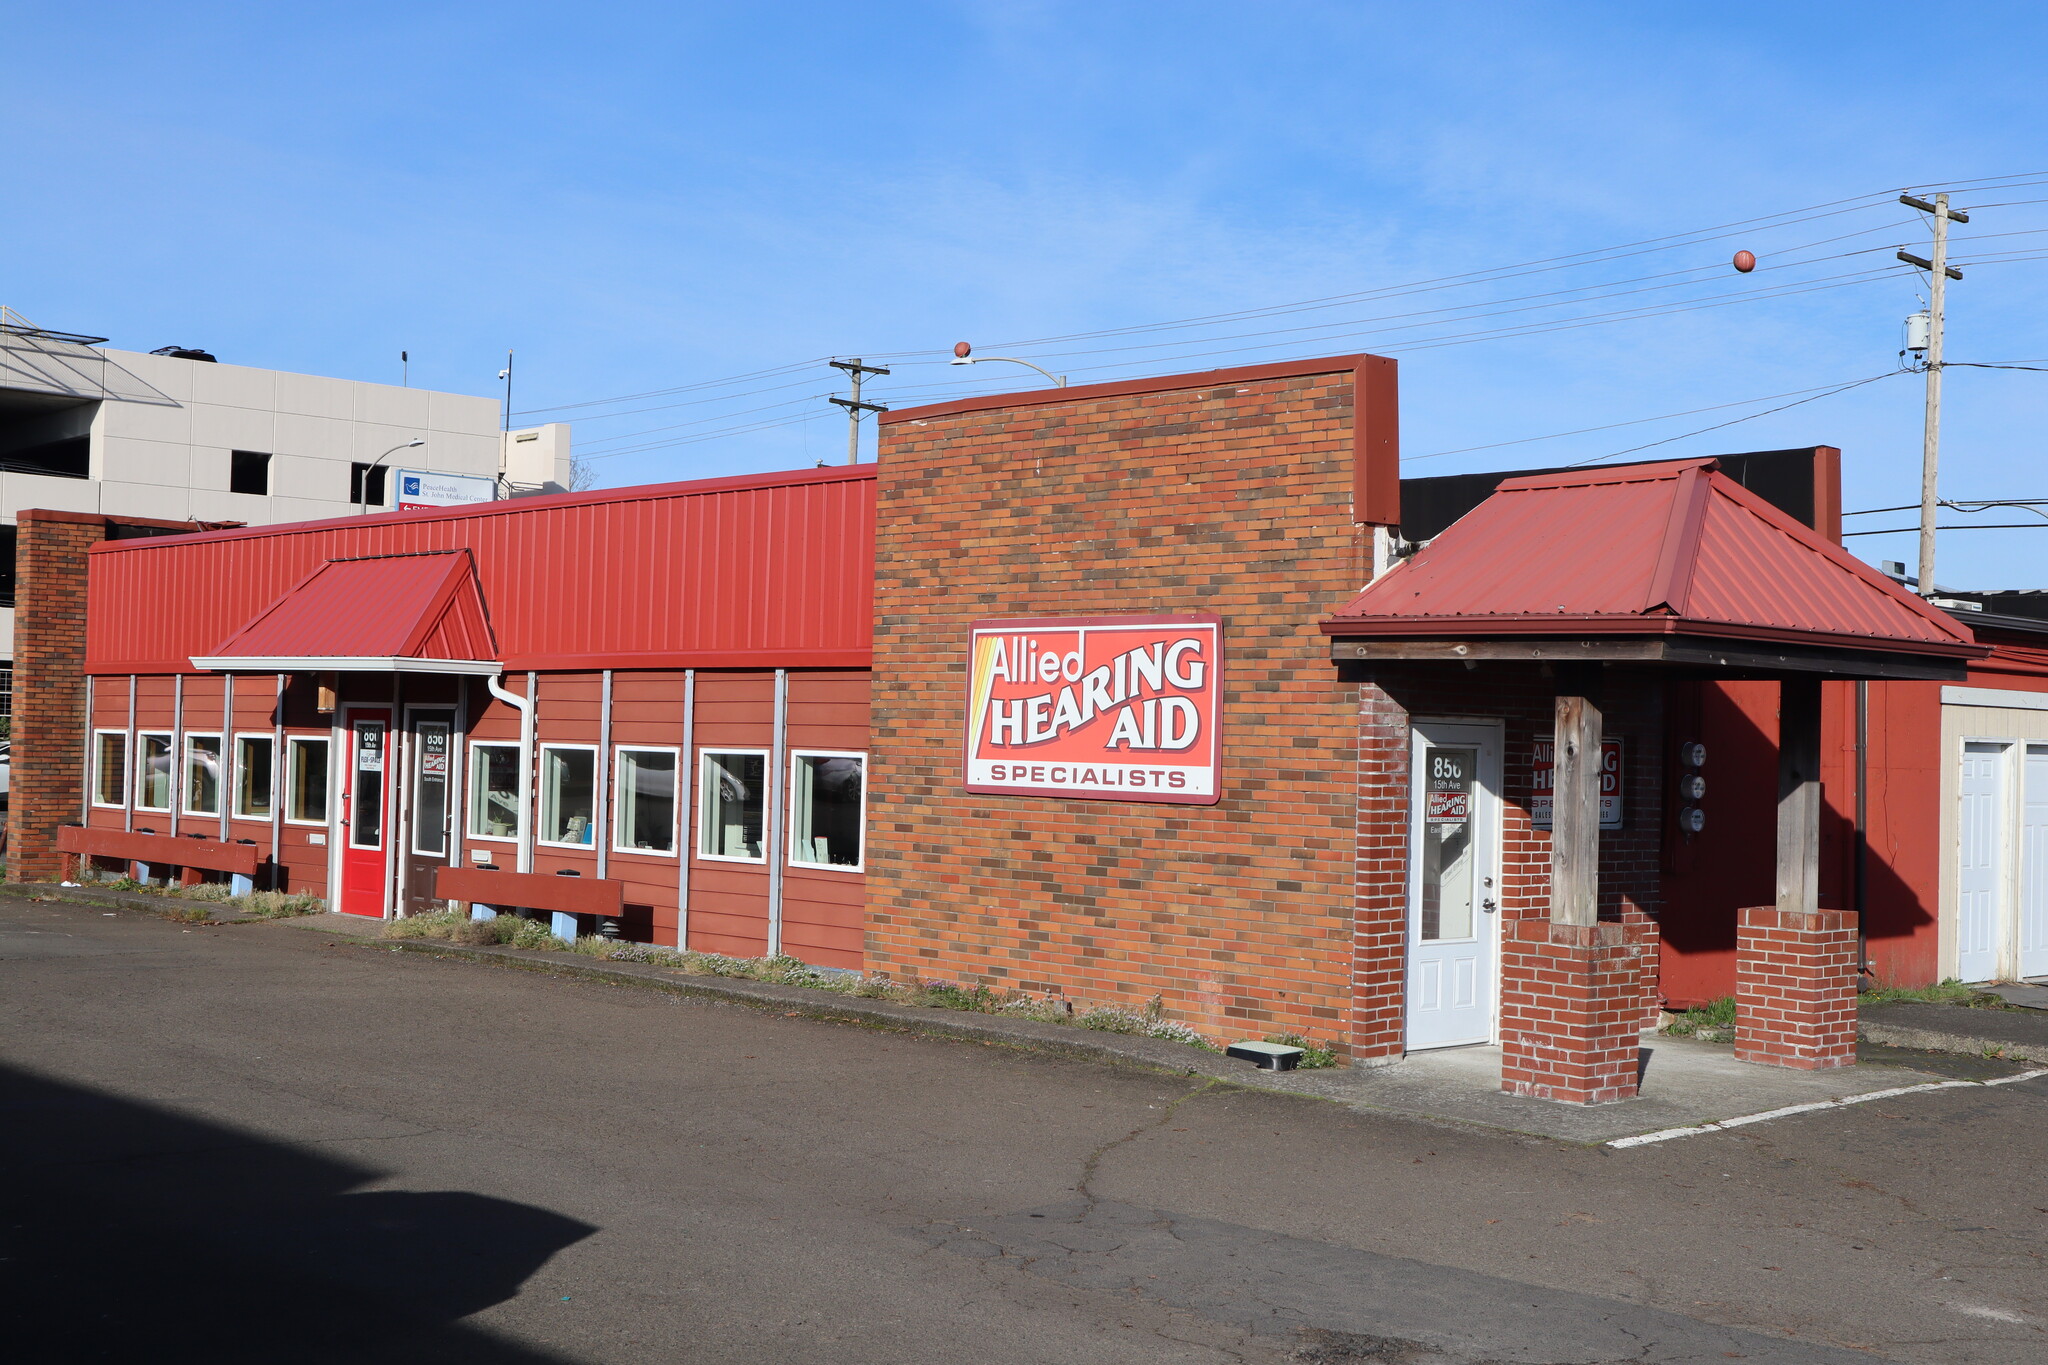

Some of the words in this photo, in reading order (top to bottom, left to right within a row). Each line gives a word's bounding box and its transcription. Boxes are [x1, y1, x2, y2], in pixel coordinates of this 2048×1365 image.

[423, 484, 458, 492] PeaceHealth
[991, 629, 1085, 684] Allied
[989, 638, 1207, 746] HEARING
[1105, 695, 1200, 751] AID
[1532, 744, 1554, 765] Alli
[991, 764, 1187, 789] SPECIALISTS
[1434, 757, 1462, 778] 856
[1434, 780, 1447, 790] 15th
[1448, 781, 1461, 790] Ave
[1430, 795, 1466, 815] HEARING
[1431, 793, 1448, 803] Allied
[1450, 806, 1465, 815] AID
[1430, 826, 1442, 834] East
